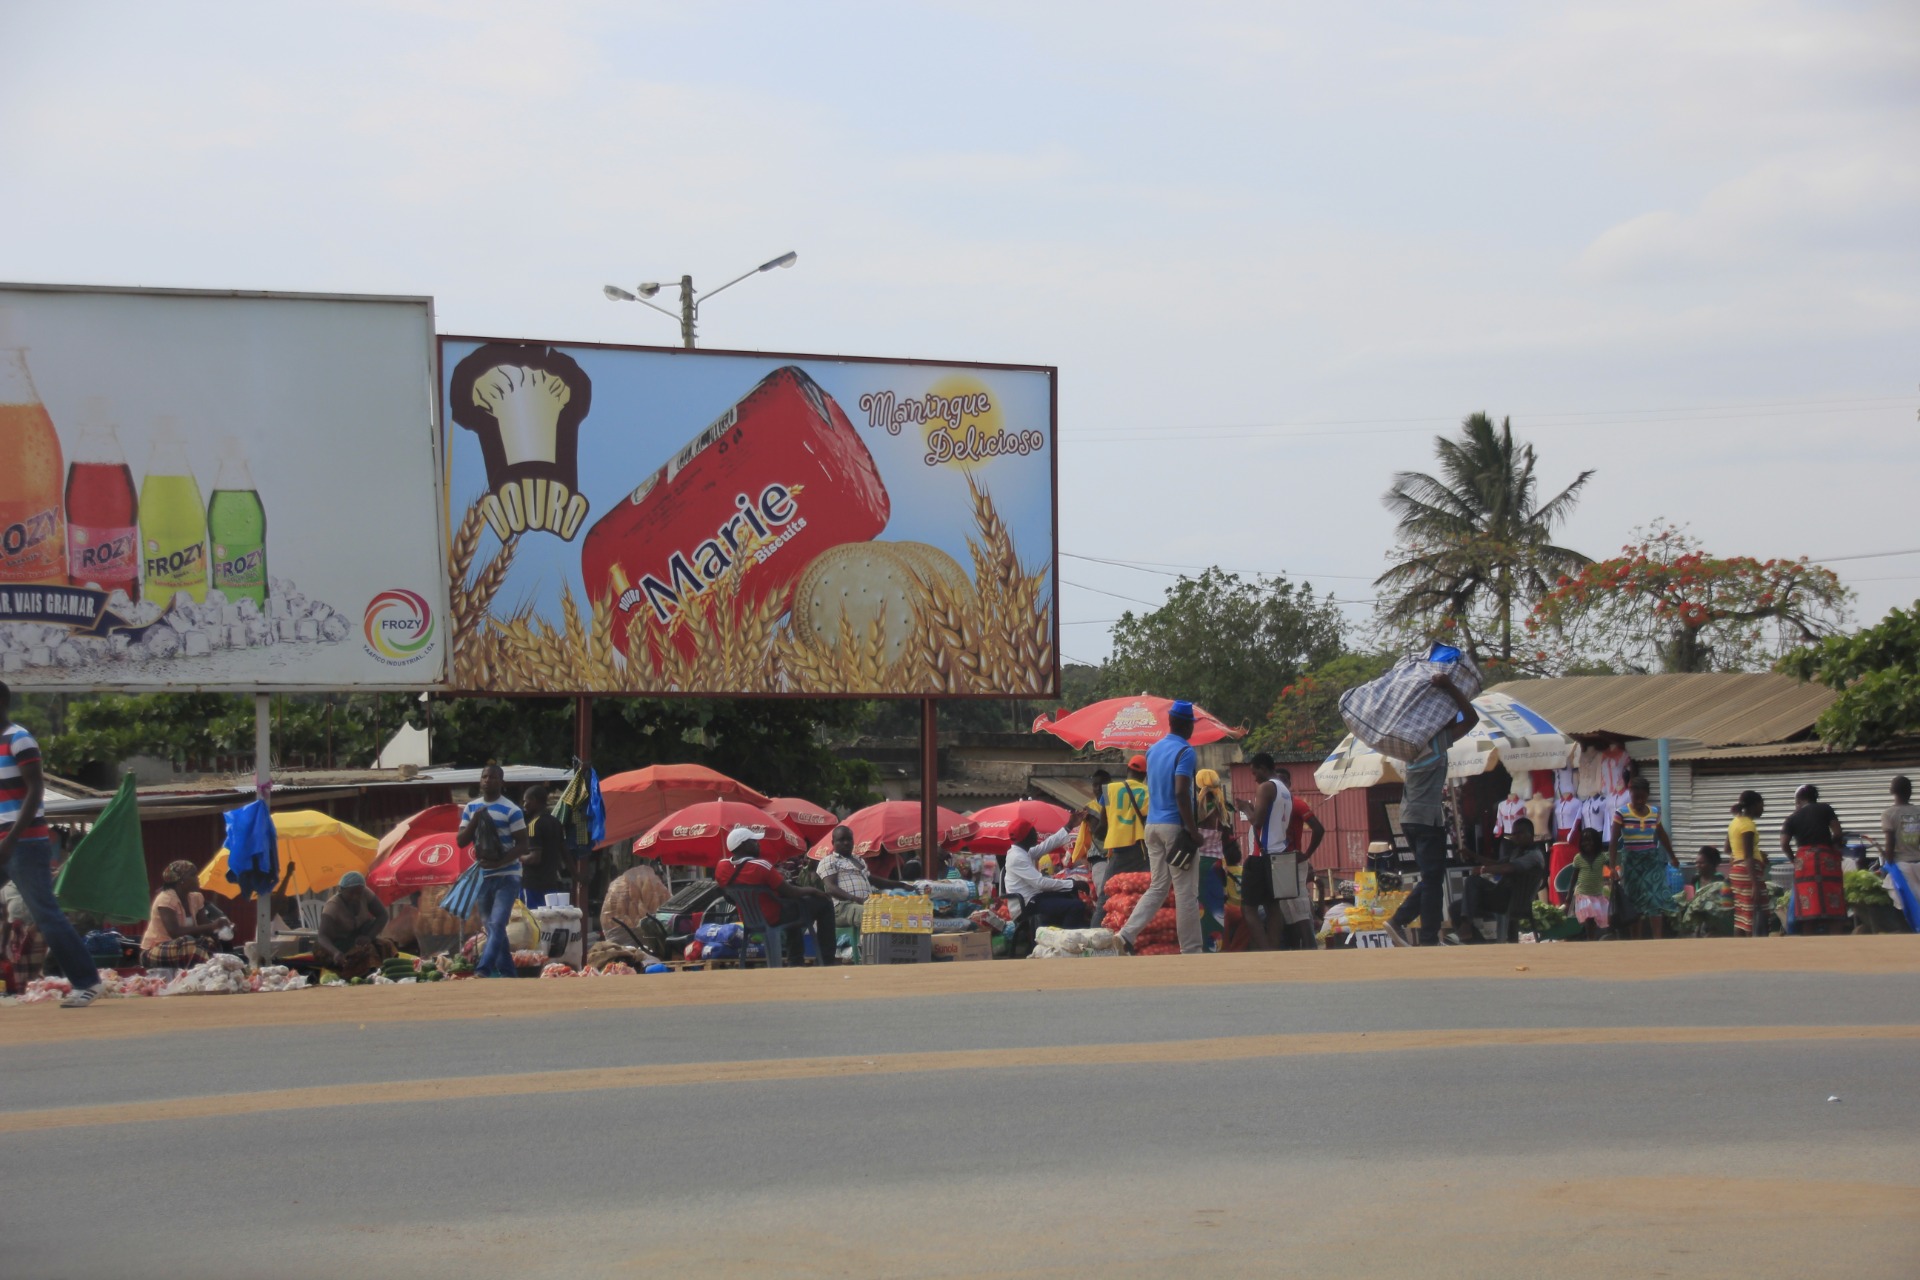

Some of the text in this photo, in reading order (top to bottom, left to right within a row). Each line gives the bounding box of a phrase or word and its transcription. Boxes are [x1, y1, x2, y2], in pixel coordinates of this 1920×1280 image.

[859, 391, 991, 435] Maningue
[924, 425, 1043, 466] Delicioso
[482, 478, 588, 542] DOURO
[0, 505, 59, 559] OZY
[753, 517, 807, 564] Biscuits
[147, 541, 204, 577] FROZY
[215, 548, 264, 577] FROZY
[639, 483, 798, 624] Marie
[0, 592, 96, 617] R, VAIS GRAMAR.
[382, 620, 421, 630] FROZY
